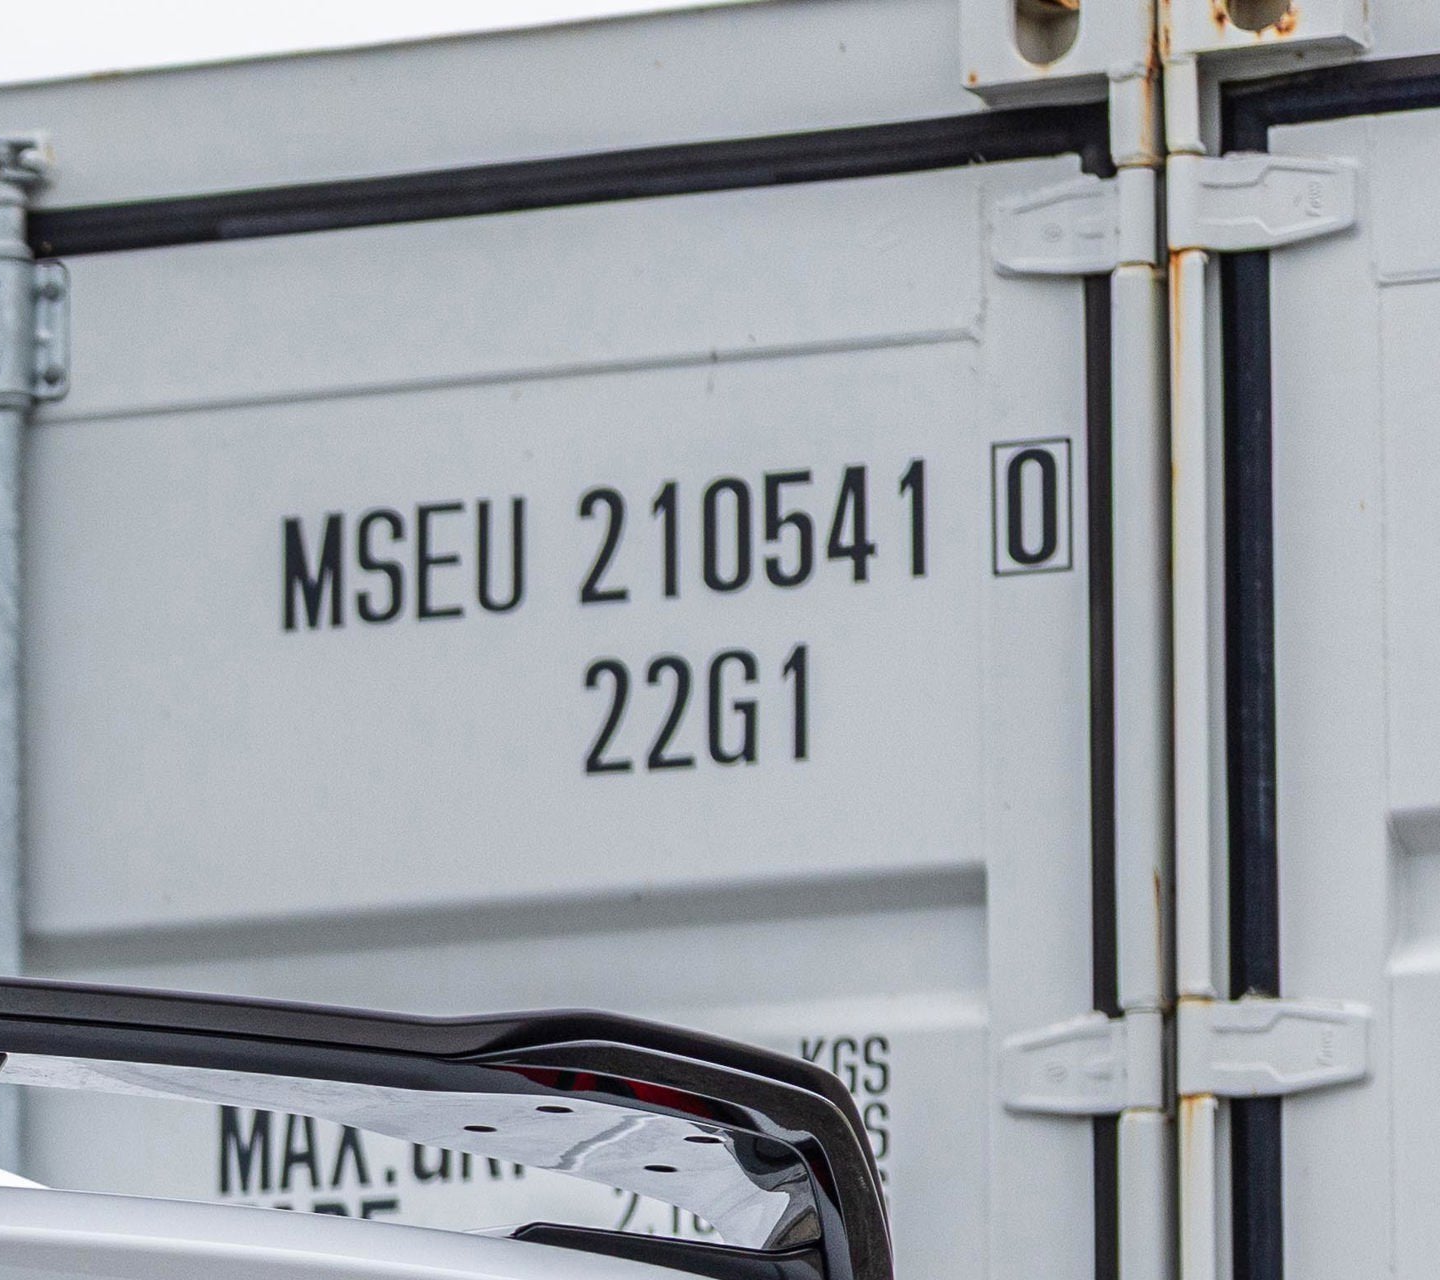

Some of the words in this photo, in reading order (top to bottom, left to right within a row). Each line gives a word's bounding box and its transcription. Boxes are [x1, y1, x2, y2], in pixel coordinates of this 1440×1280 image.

[283, 497, 526, 633] MSEU
[578, 459, 927, 605] 210541
[1005, 447, 1058, 567] 0
[583, 645, 808, 776] 22G1
